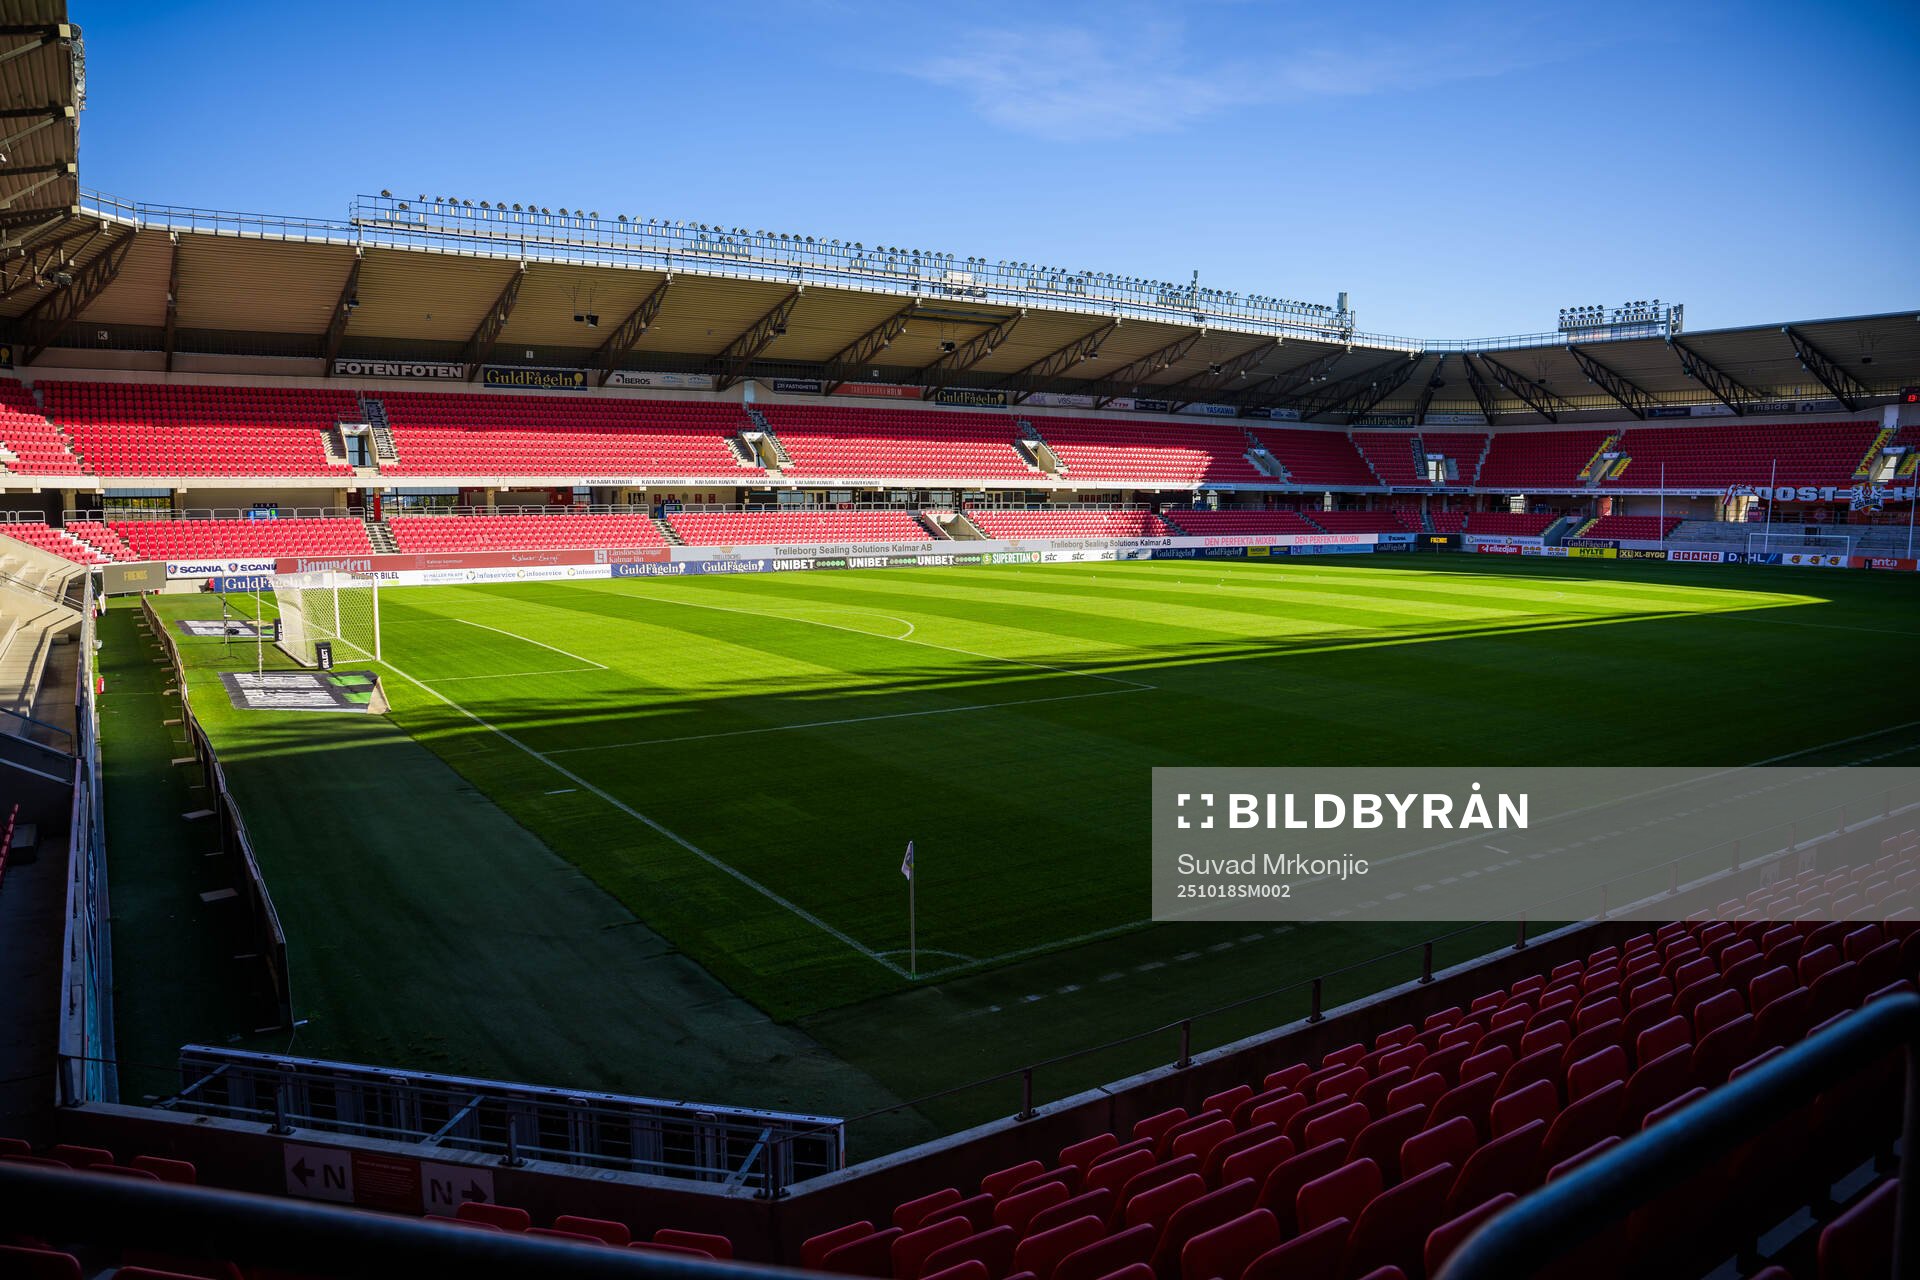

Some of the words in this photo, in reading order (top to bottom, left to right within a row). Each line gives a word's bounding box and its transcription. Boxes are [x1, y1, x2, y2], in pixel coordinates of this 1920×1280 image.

[486, 370, 574, 388] GuldFågeln
[937, 391, 997, 406] GuldFågeln
[1206, 406, 1235, 415] YASKAWA
[1051, 540, 1084, 550] Trelleborg
[1085, 540, 1109, 550] Sealing
[1110, 540, 1139, 548] Solutions
[1140, 539, 1161, 547] Kalmar
[1162, 538, 1172, 546] AB
[1204, 537, 1220, 546] DEN
[1221, 537, 1254, 546] PERFEKTA
[1255, 536, 1277, 545] MIXEN
[1295, 536, 1308, 544] DEN
[1309, 535, 1339, 544] PERFEKTA
[1340, 535, 1360, 543] MIXEN
[775, 546, 817, 556] Trelleborg
[819, 545, 850, 555] Sealing
[852, 544, 890, 554] Solutions
[891, 543, 919, 552] Kalmar
[921, 543, 933, 551] AB
[917, 556, 954, 566] UNIBET
[992, 552, 1031, 564] SUPERETTAN
[1673, 552, 1718, 560] CRAMO
[1728, 553, 1765, 563] DHL
[702, 560, 758, 572] GuldFågeln
[773, 559, 815, 571] UNIBET
[849, 557, 888, 568] UNIBET
[180, 565, 223, 574] SCANIA
[576, 567, 610, 576] infoservice
[619, 562, 679, 575] GuldFågeln
[476, 572, 516, 580] infoservice
[323, 1164, 346, 1190] N
[431, 1178, 453, 1205] N
